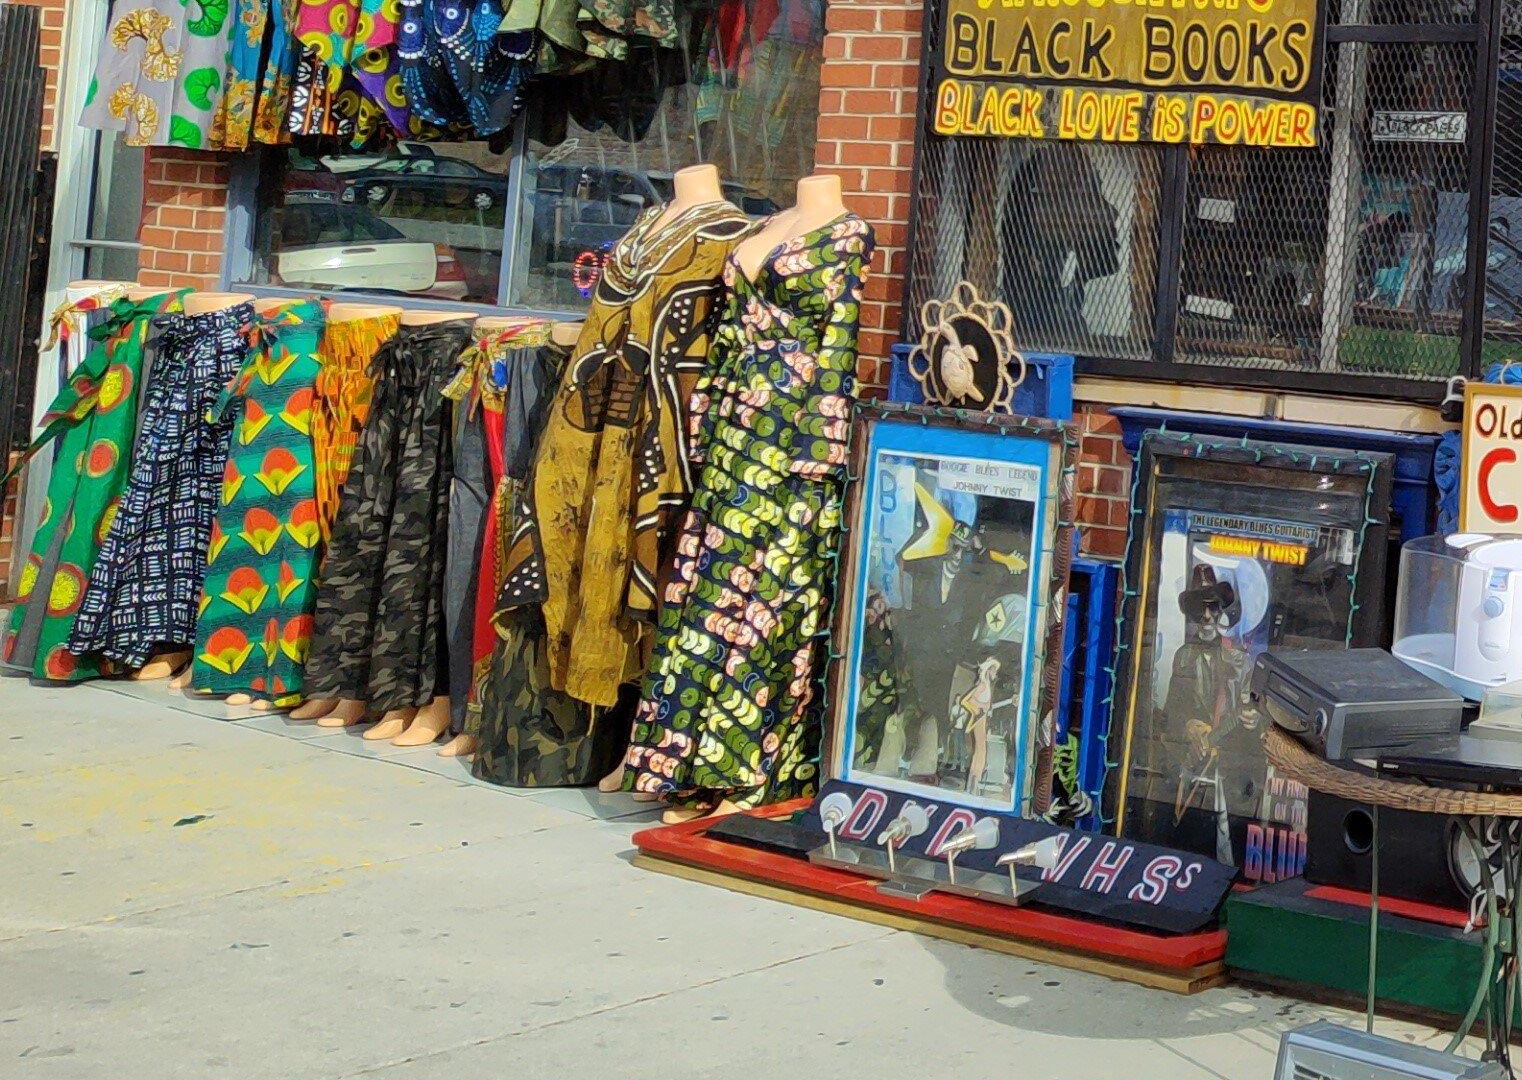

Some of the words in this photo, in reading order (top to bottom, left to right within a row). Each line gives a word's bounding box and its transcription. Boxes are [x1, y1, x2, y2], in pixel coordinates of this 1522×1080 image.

[949, 13, 1115, 79] BLACK
[1142, 15, 1310, 92] BOOKS
[934, 77, 1043, 137] BLACK
[1060, 87, 1142, 141] LOVE
[1191, 94, 1316, 147] POWER
[940, 460, 968, 473] BOOGIE
[1008, 468, 1038, 482] LEGEND
[953, 481, 989, 494] JOHNNY
[993, 485, 1022, 498] TWIST
[1206, 516, 1248, 530] LEGENDARY
[1250, 521, 1274, 535] BLUES
[1262, 541, 1310, 565] TWIST
